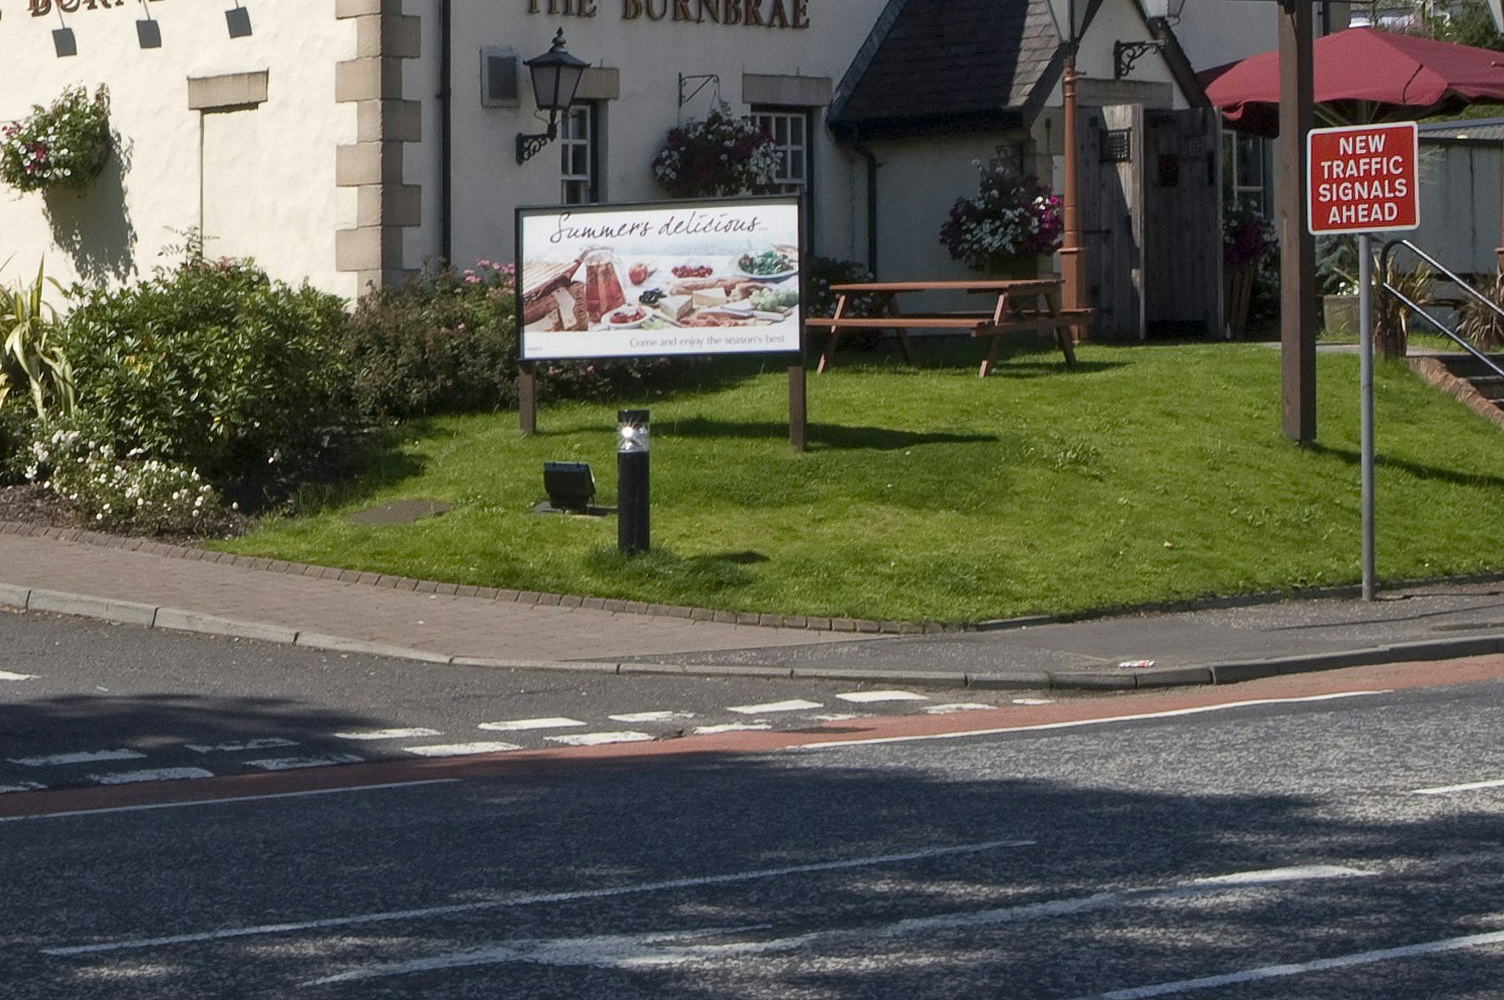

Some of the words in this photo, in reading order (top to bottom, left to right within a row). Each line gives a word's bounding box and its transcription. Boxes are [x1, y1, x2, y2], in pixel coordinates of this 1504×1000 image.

[1339, 134, 1385, 155] NEW
[1320, 155, 1404, 180] TRAFFIC
[1318, 178, 1408, 202] SIGNALS
[1328, 202, 1398, 224] AHEAD
[549, 211, 653, 243] Summer's
[629, 337, 657, 348] Come
[660, 334, 678, 347] and
[679, 335, 705, 349] enjoy
[706, 333, 722, 345] the
[724, 333, 763, 345] season's
[765, 332, 786, 344] best
